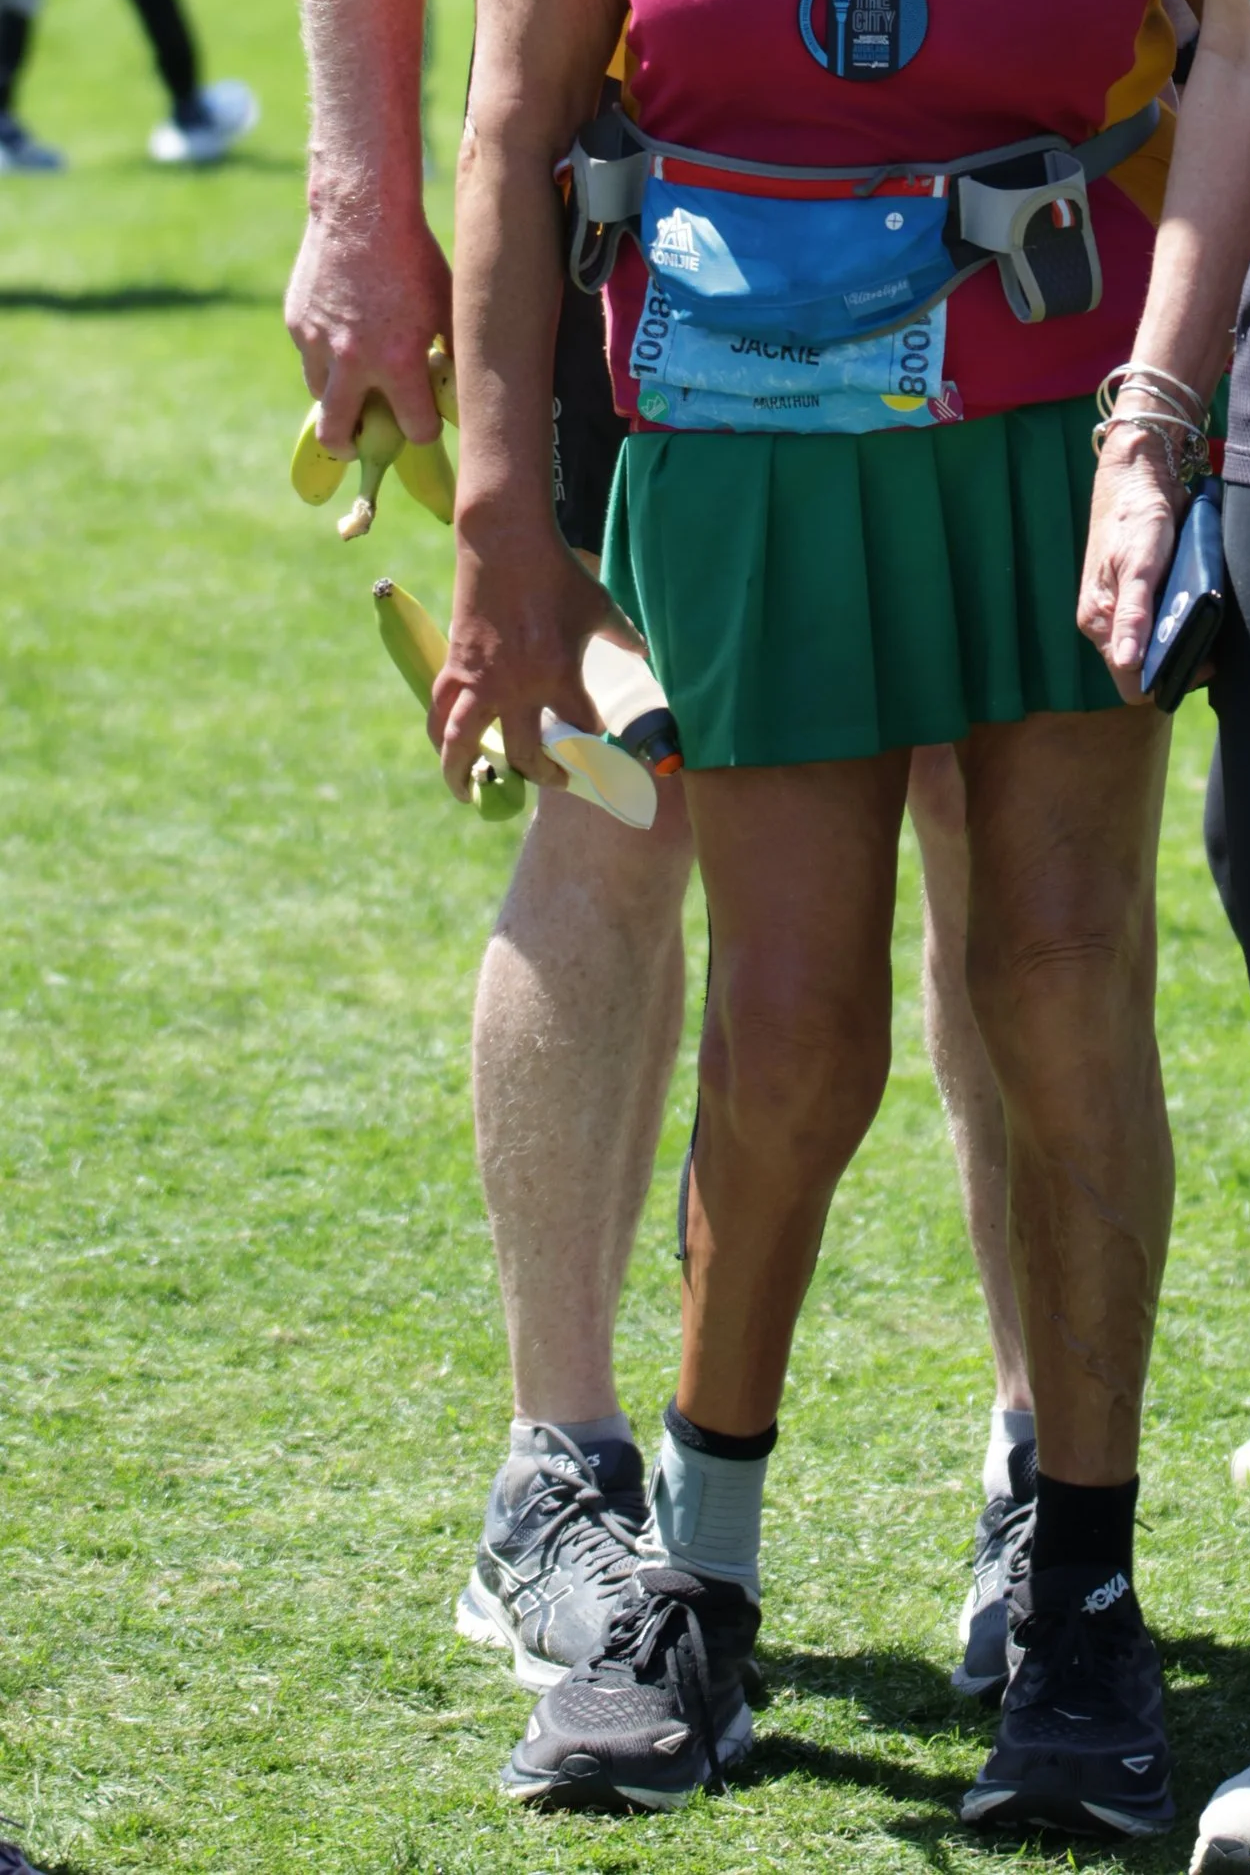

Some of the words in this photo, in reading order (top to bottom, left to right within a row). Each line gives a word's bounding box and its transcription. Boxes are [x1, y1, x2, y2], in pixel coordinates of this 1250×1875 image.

[852, 10, 896, 33] CITY
[650, 248, 700, 272] AONIJIE
[730, 336, 821, 366] JACKIE
[1081, 1572, 1130, 1615] HOKA
